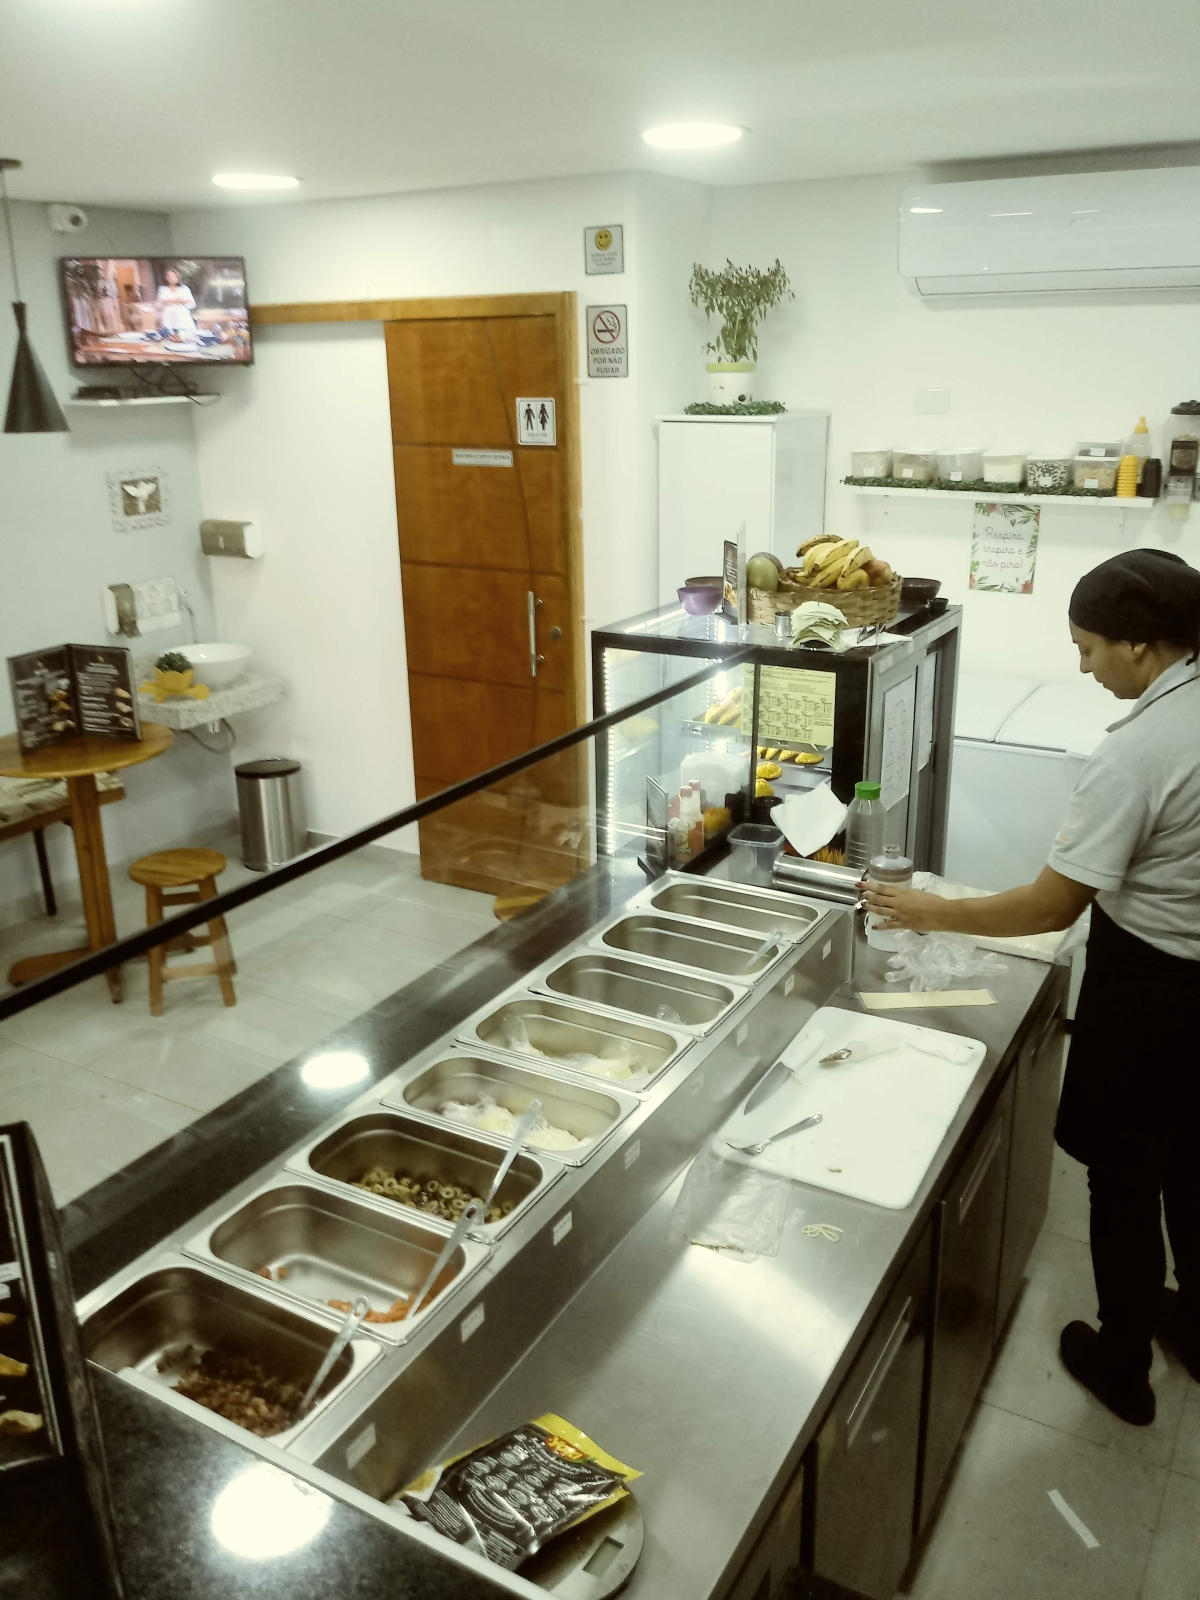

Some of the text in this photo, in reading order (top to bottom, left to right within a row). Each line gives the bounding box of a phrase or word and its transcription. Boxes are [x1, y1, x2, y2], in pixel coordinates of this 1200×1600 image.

[590, 347, 625, 356] OBRIGADO
[593, 356, 623, 365] POR NÃO
[597, 367, 620, 375] FUMAR
[982, 558, 999, 568] não
